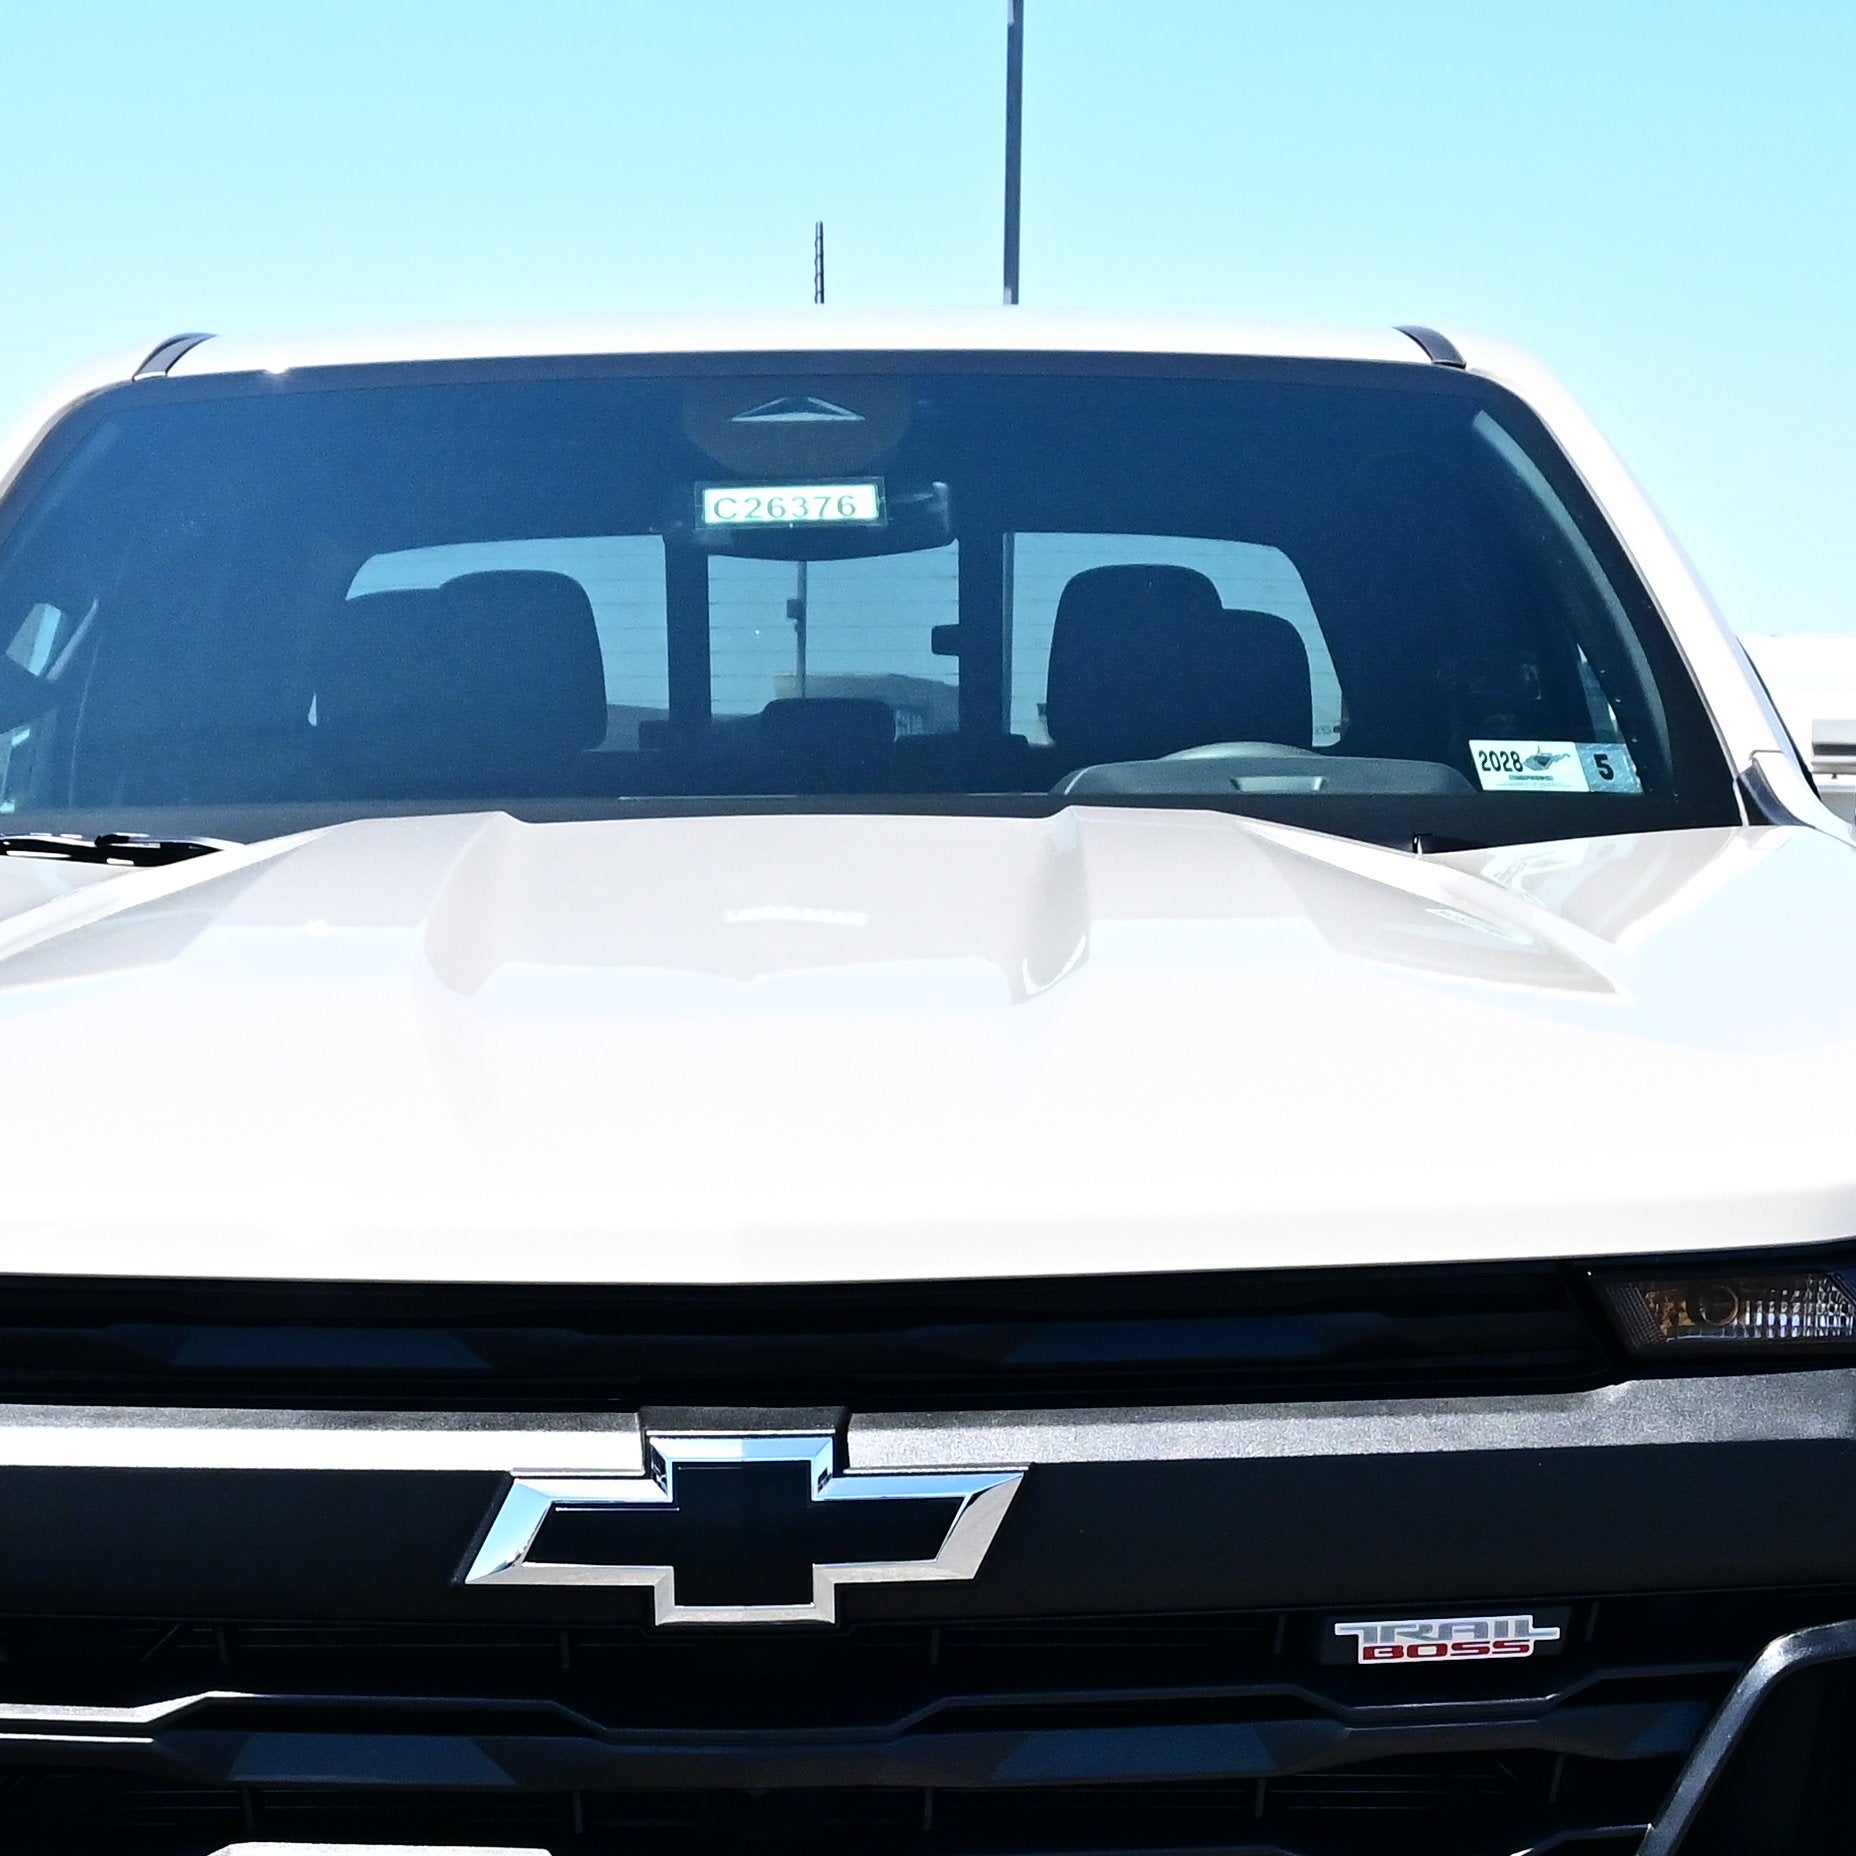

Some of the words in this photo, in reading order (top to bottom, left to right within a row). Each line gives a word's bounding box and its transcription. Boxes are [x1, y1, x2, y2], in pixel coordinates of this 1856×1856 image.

[712, 494, 857, 520] C26376
[1478, 749, 1524, 773] 2028
[1593, 753, 1614, 781] 5
[1336, 1616, 1560, 1644] TRAIL
[1361, 1639, 1531, 1661] BOSS
